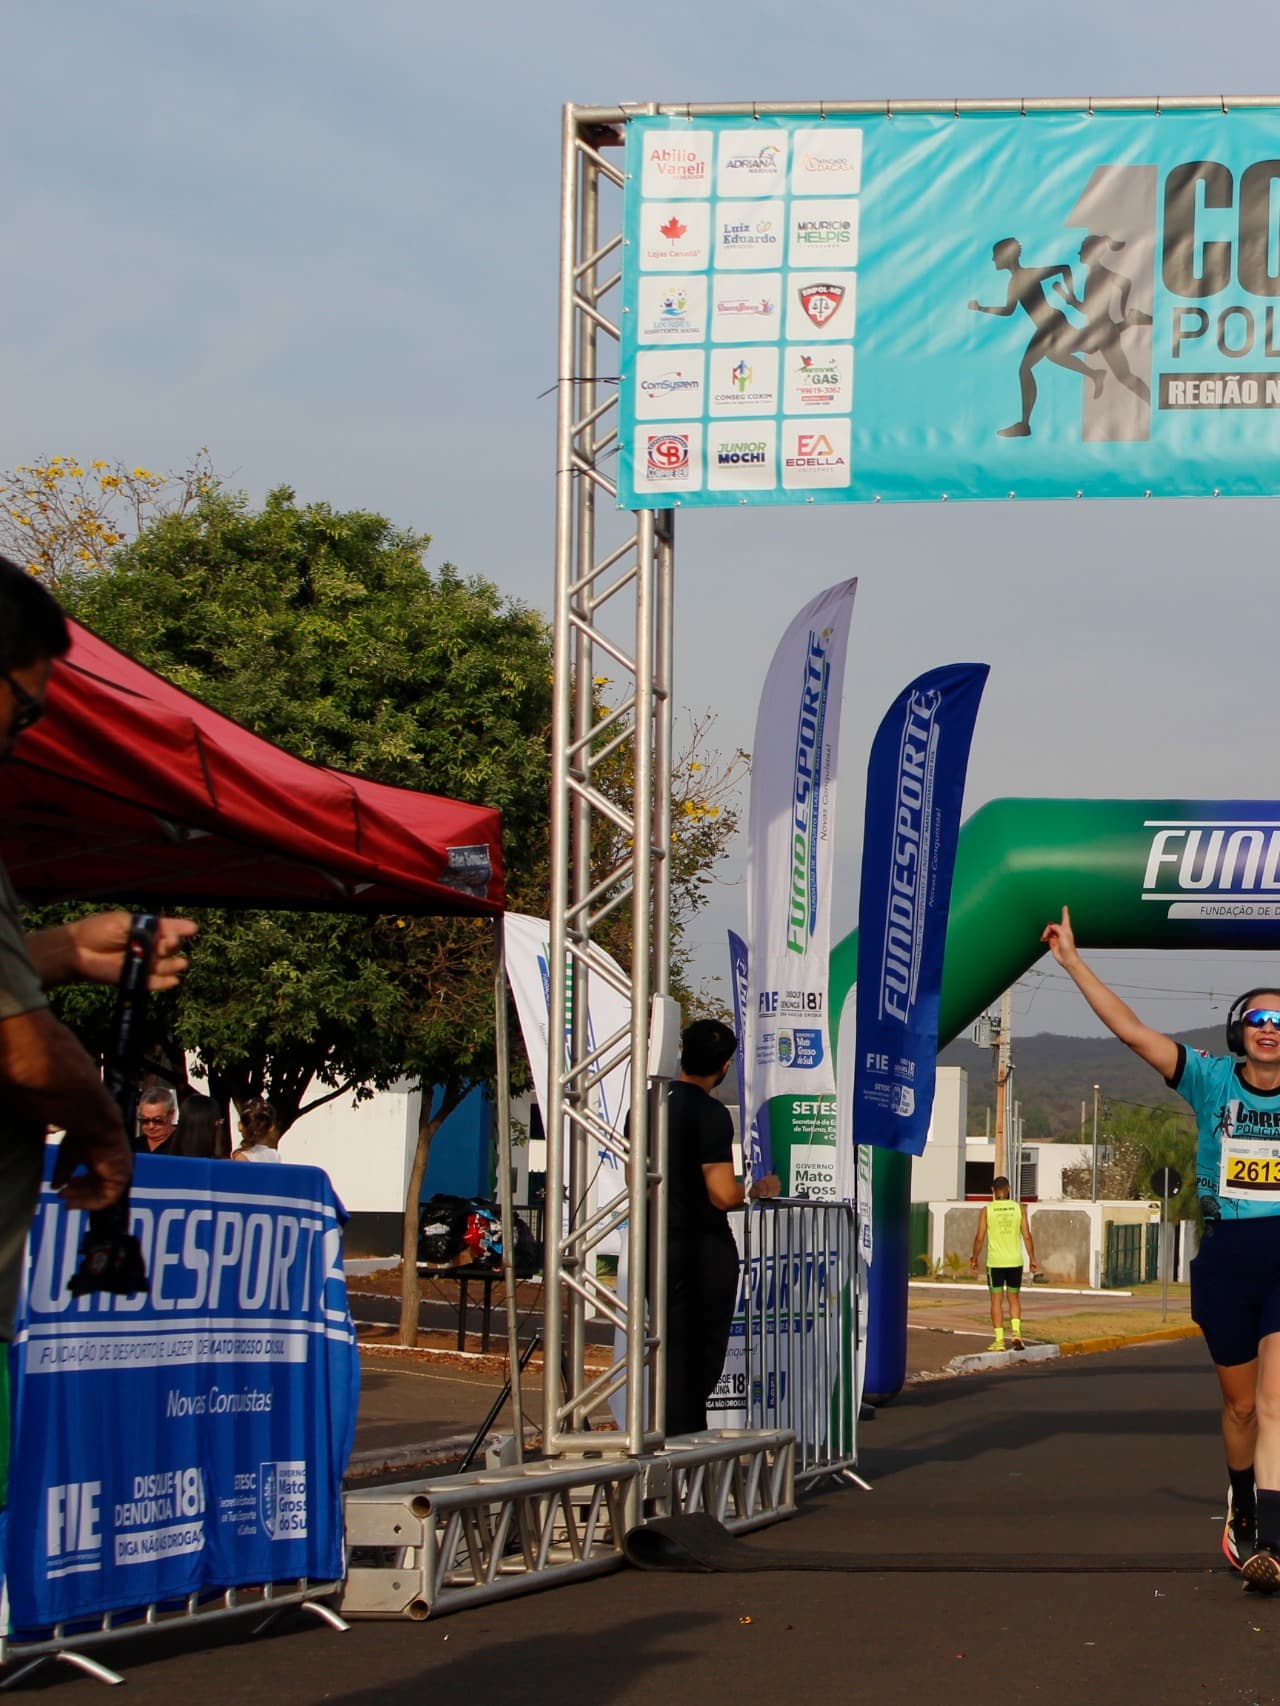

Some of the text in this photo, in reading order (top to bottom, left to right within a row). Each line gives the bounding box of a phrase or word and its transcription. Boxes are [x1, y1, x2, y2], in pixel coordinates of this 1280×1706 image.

[726, 159, 777, 169] ADRIANA
[724, 222, 750, 234] Luiz
[723, 233, 776, 245] Eduardo
[811, 374, 839, 385] GAS
[1168, 375, 1258, 404] REGIÃO
[718, 452, 765, 465] MOCHI
[786, 457, 845, 468] EDELLA
[787, 634, 826, 955] FUNDESPORTE
[885, 695, 937, 1022] FUNDESPORTE
[1200, 904, 1253, 918] FUNDAÇÃO
[1257, 906, 1270, 916] DE
[759, 991, 778, 1013] FIE
[866, 1053, 889, 1070] FIE
[795, 1170, 833, 1183] Mato
[279, 1479, 306, 1494] Mato
[47, 1480, 101, 1557] FIE
[279, 1517, 290, 1531] do
